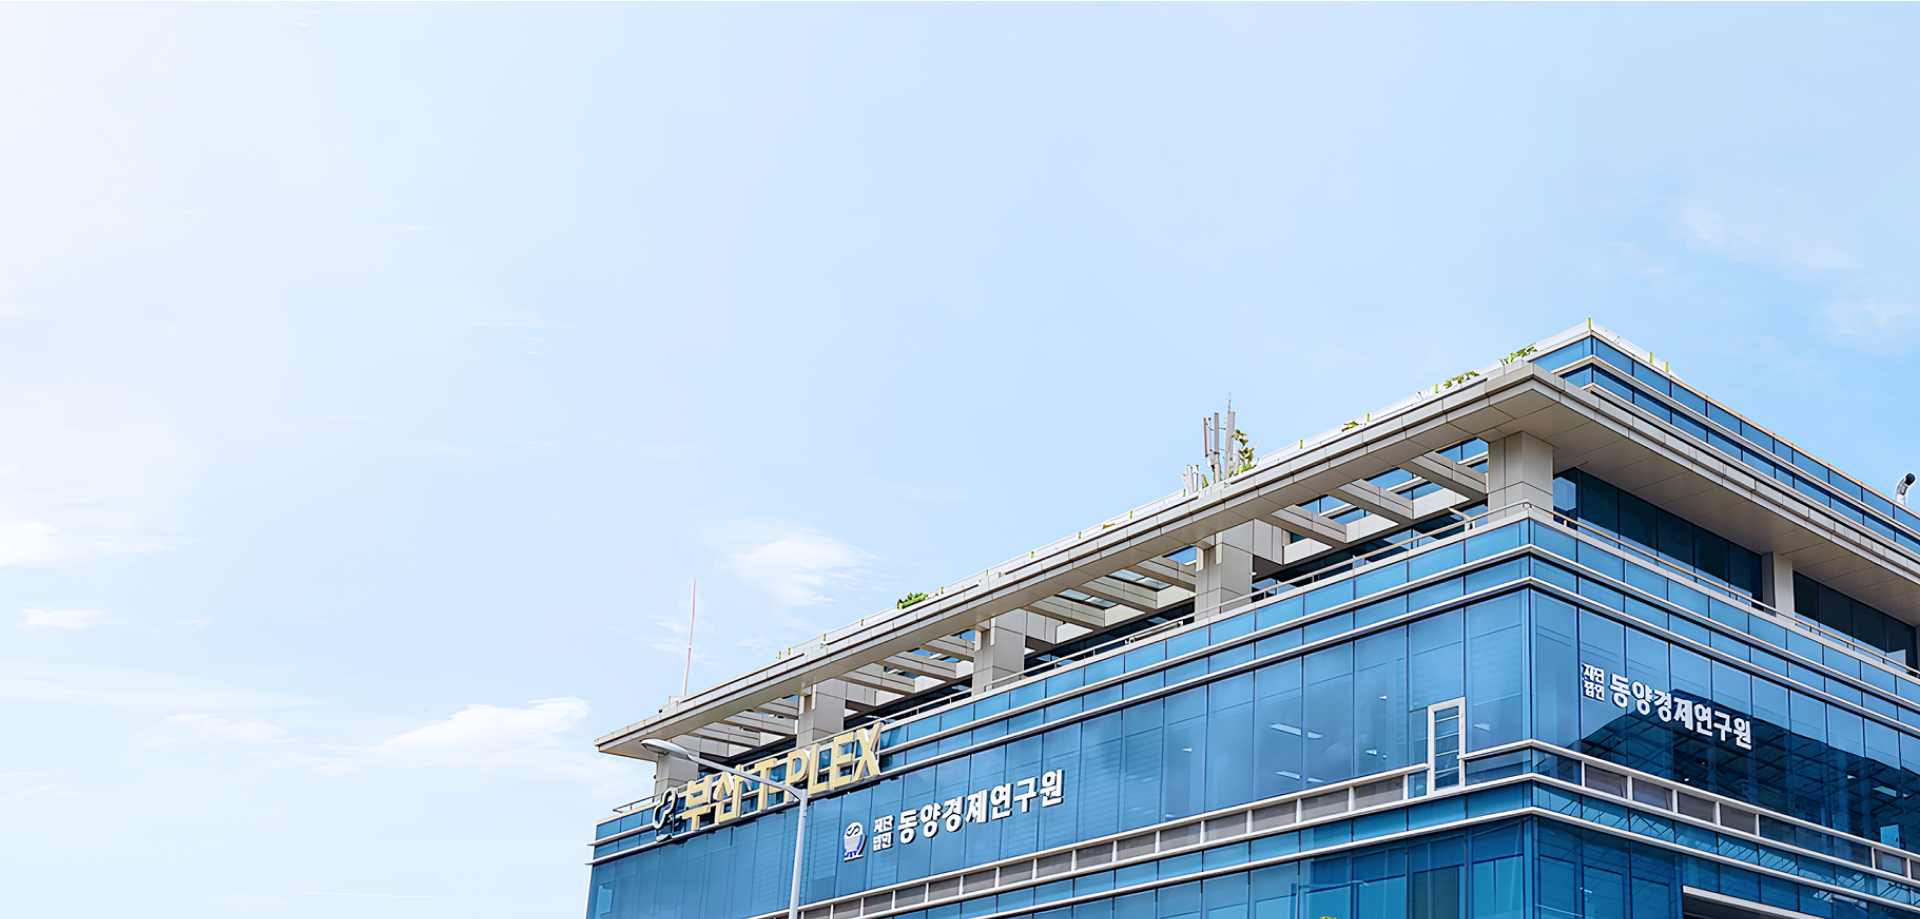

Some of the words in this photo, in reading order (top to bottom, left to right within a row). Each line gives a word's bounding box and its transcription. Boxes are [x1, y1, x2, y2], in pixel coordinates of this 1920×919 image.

[1609, 672, 1752, 749] 동양경제연구원
[677, 763, 751, 832] 부산
[897, 769, 1064, 844] 동양경제연구원
